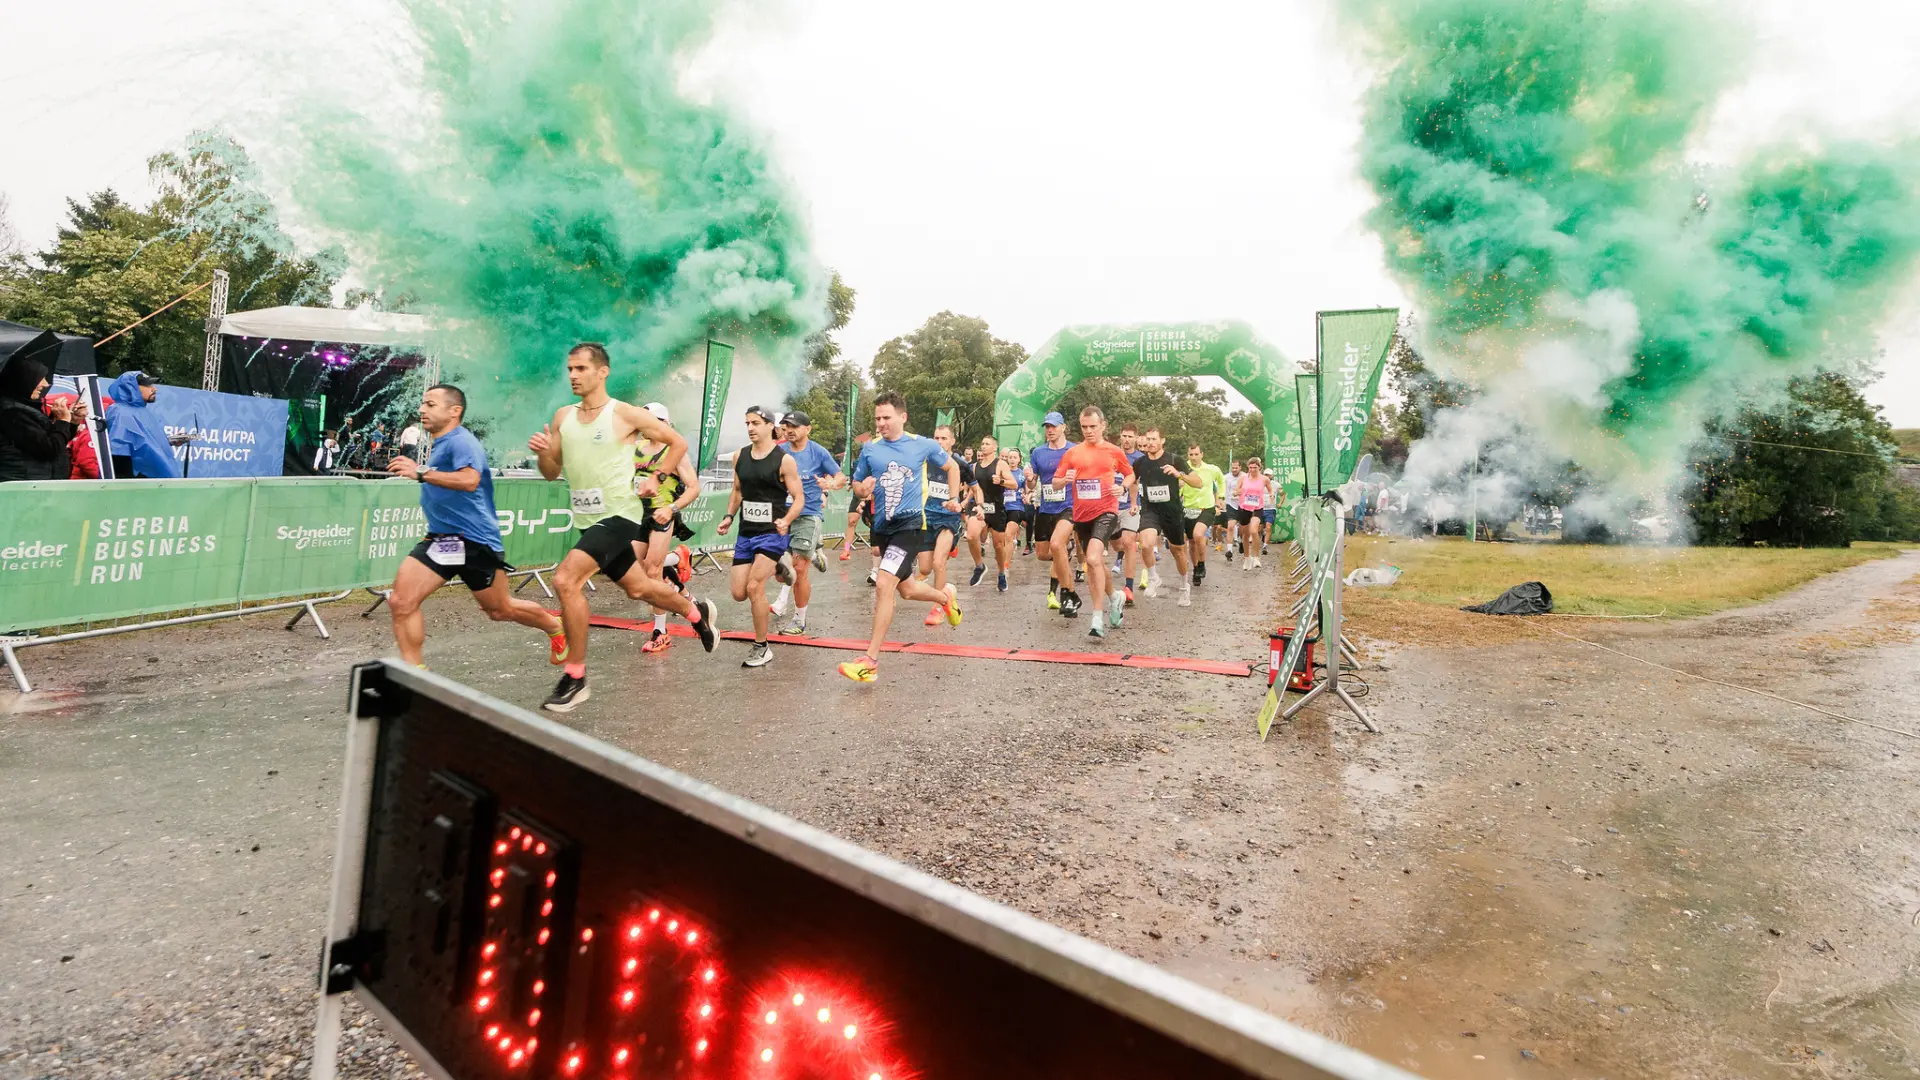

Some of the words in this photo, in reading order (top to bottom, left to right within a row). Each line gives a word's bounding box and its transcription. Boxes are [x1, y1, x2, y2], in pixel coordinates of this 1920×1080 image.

[1147, 331, 1185, 340] SERBIA
[1093, 340, 1137, 349] Schneider
[1146, 341, 1200, 351] BUSINESS
[1146, 353, 1168, 362] RUN
[1355, 344, 1372, 403] Electric
[1334, 342, 1359, 450] Schneider
[163, 426, 186, 441] ВИ
[222, 430, 256, 445] ИГРА
[171, 445, 251, 462] УДУЋНОСТ
[1272, 445, 1301, 453] Schneide
[1272, 458, 1300, 466] SERBI
[573, 497, 601, 507] 2144
[686, 497, 709, 509] BIA
[373, 507, 425, 523] SERBIA
[744, 507, 770, 518] 1404
[98, 516, 189, 538] SERBIA
[496, 509, 574, 536] BYD
[277, 524, 354, 540] Schneider
[371, 523, 430, 541] BUSINES
[0, 540, 68, 559] eider
[94, 535, 217, 561] BUSINESS
[311, 538, 352, 548] Electric
[369, 543, 397, 559] RUN
[91, 562, 144, 584] RUN
